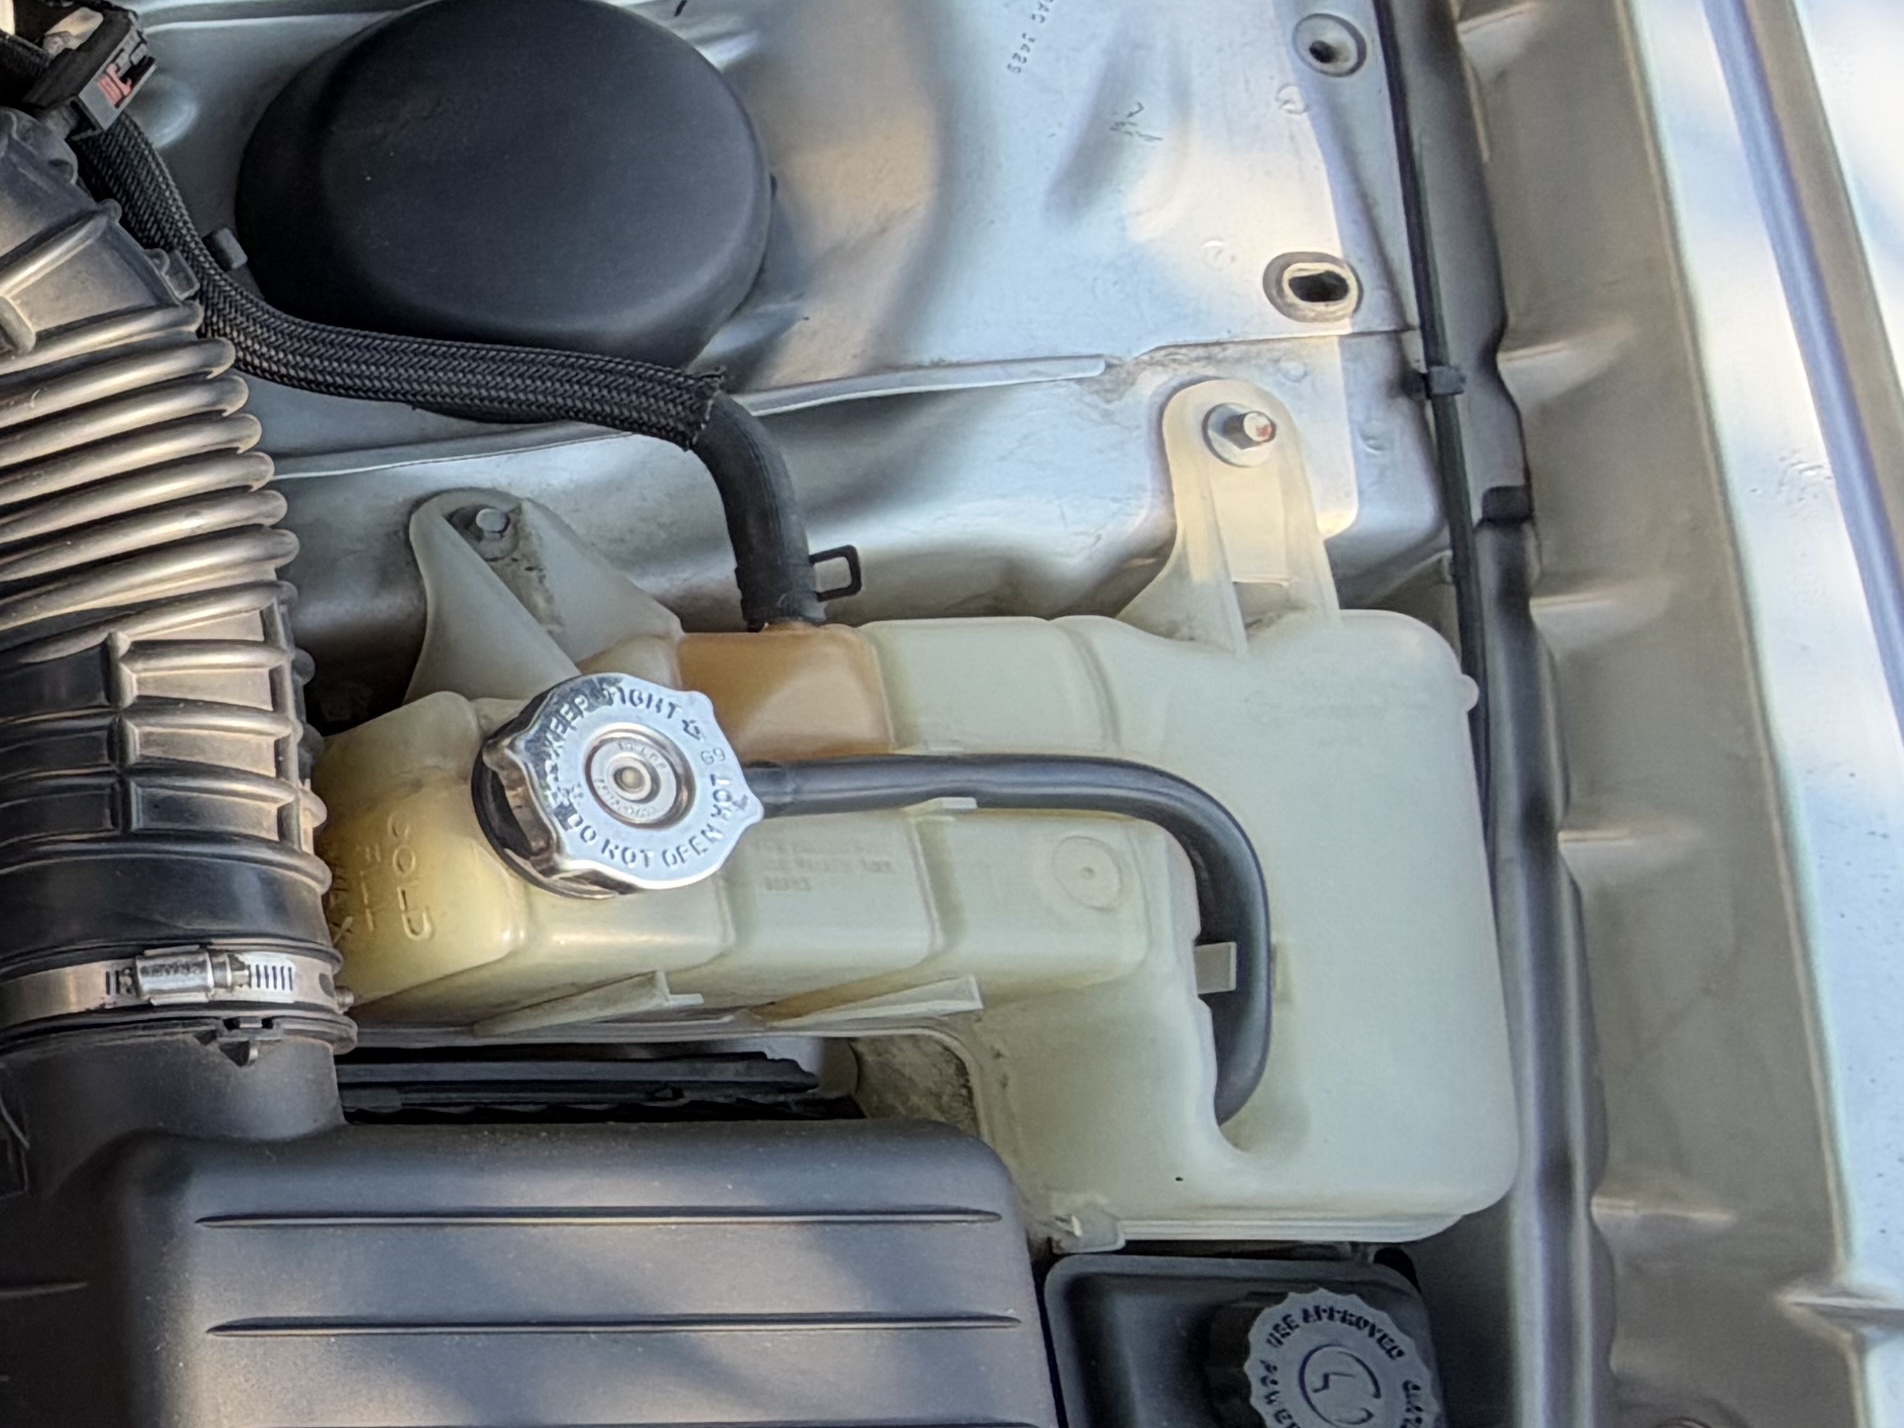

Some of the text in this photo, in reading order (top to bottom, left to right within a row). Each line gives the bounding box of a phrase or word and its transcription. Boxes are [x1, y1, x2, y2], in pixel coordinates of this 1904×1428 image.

[601, 684, 682, 720] TIGHT
[563, 808, 597, 845] DO
[601, 838, 654, 868] NOT
[661, 822, 724, 869] OPEN
[1266, 1305, 1406, 1361] USE APPROVED
